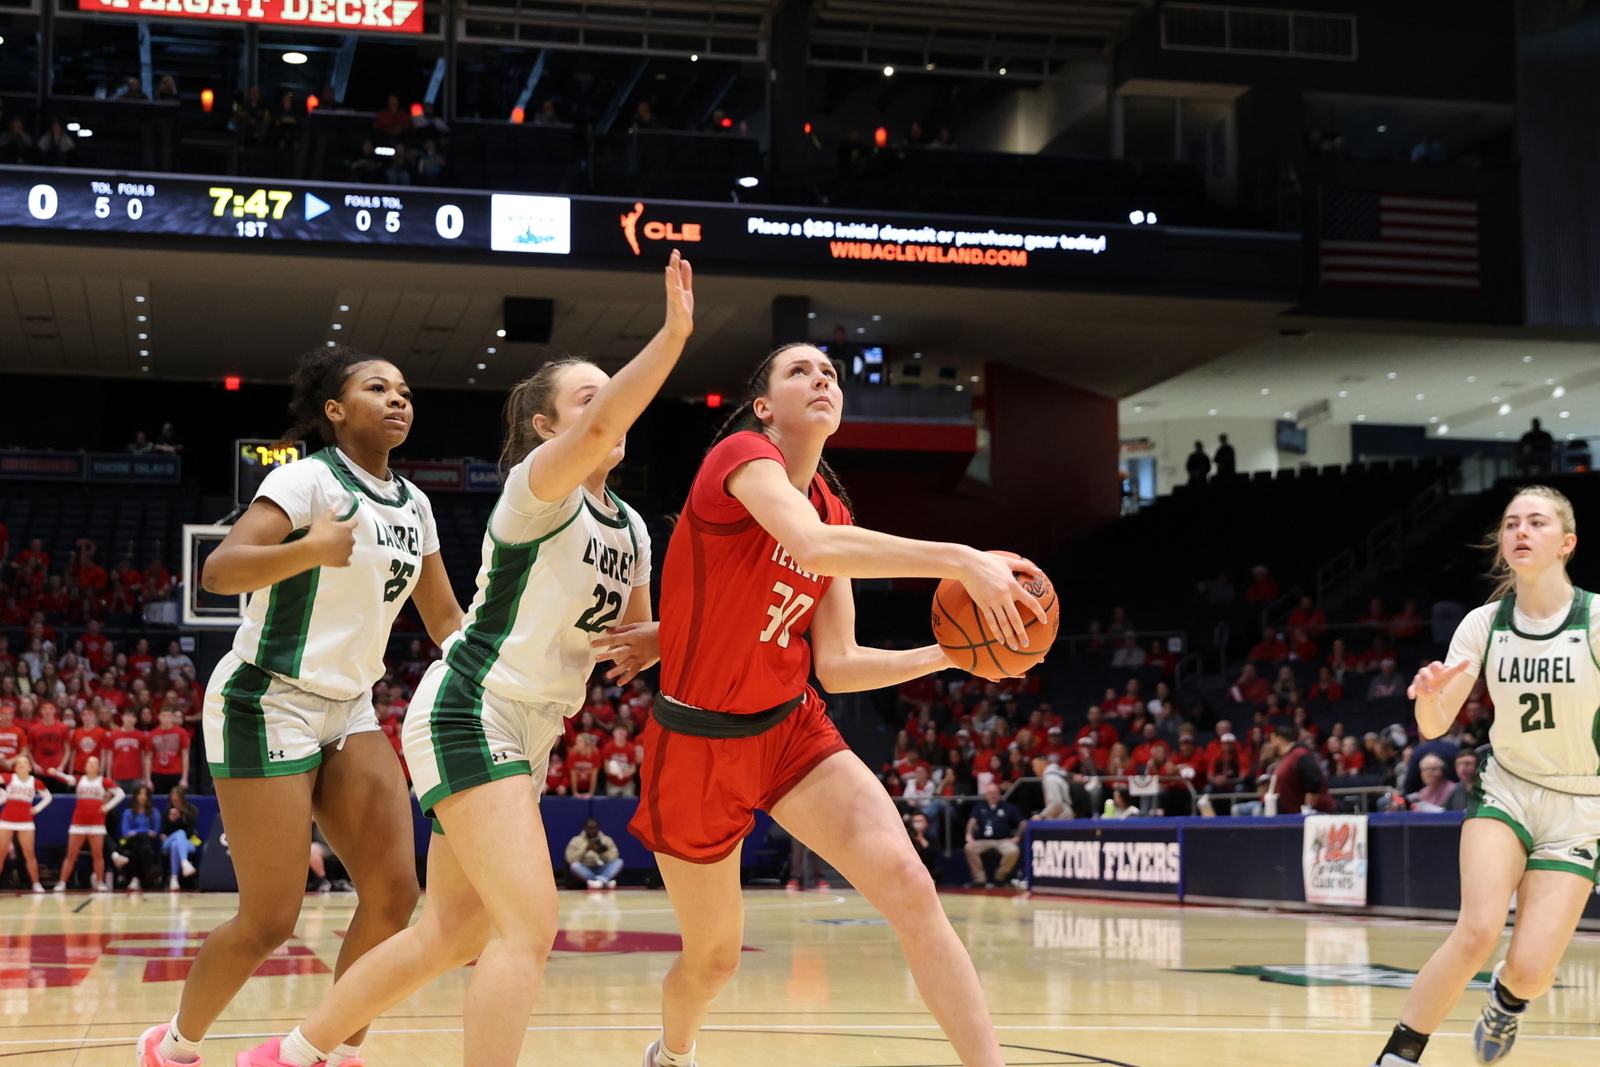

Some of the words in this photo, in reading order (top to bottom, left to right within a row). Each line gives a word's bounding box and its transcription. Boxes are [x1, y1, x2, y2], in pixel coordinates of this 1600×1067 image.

[280, 0, 380, 27] DECK
[27, 184, 58, 220] 0
[91, 182, 114, 195] TOL
[117, 183, 155, 197] FOULS
[209, 187, 293, 219] 7:47
[344, 194, 381, 209] FOULS
[382, 197, 403, 210] TOL
[94, 197, 110, 219] 5
[126, 198, 143, 220] 0
[355, 209, 371, 231] 0
[385, 211, 401, 233] 5
[435, 204, 464, 239] 0
[235, 221, 268, 238] 1ST
[643, 221, 702, 242] CLE
[747, 217, 790, 234] Place
[790, 221, 802, 236] a
[835, 221, 879, 239] initial
[879, 224, 936, 244] deposit
[936, 230, 955, 243] or
[955, 229, 1024, 247] purchase
[1023, 234, 1059, 251] gear
[1058, 233, 1107, 254] today!
[829, 241, 1028, 267] WNBACLEVELAND.COM
[255, 446, 298, 466] 7:47
[574, 583, 623, 633] 22
[758, 580, 815, 649] 30
[1498, 656, 1576, 684] LAUREL
[1518, 692, 1556, 734] 21
[1031, 840, 1101, 880] DAYTON
[1102, 842, 1181, 884] FLYERS
